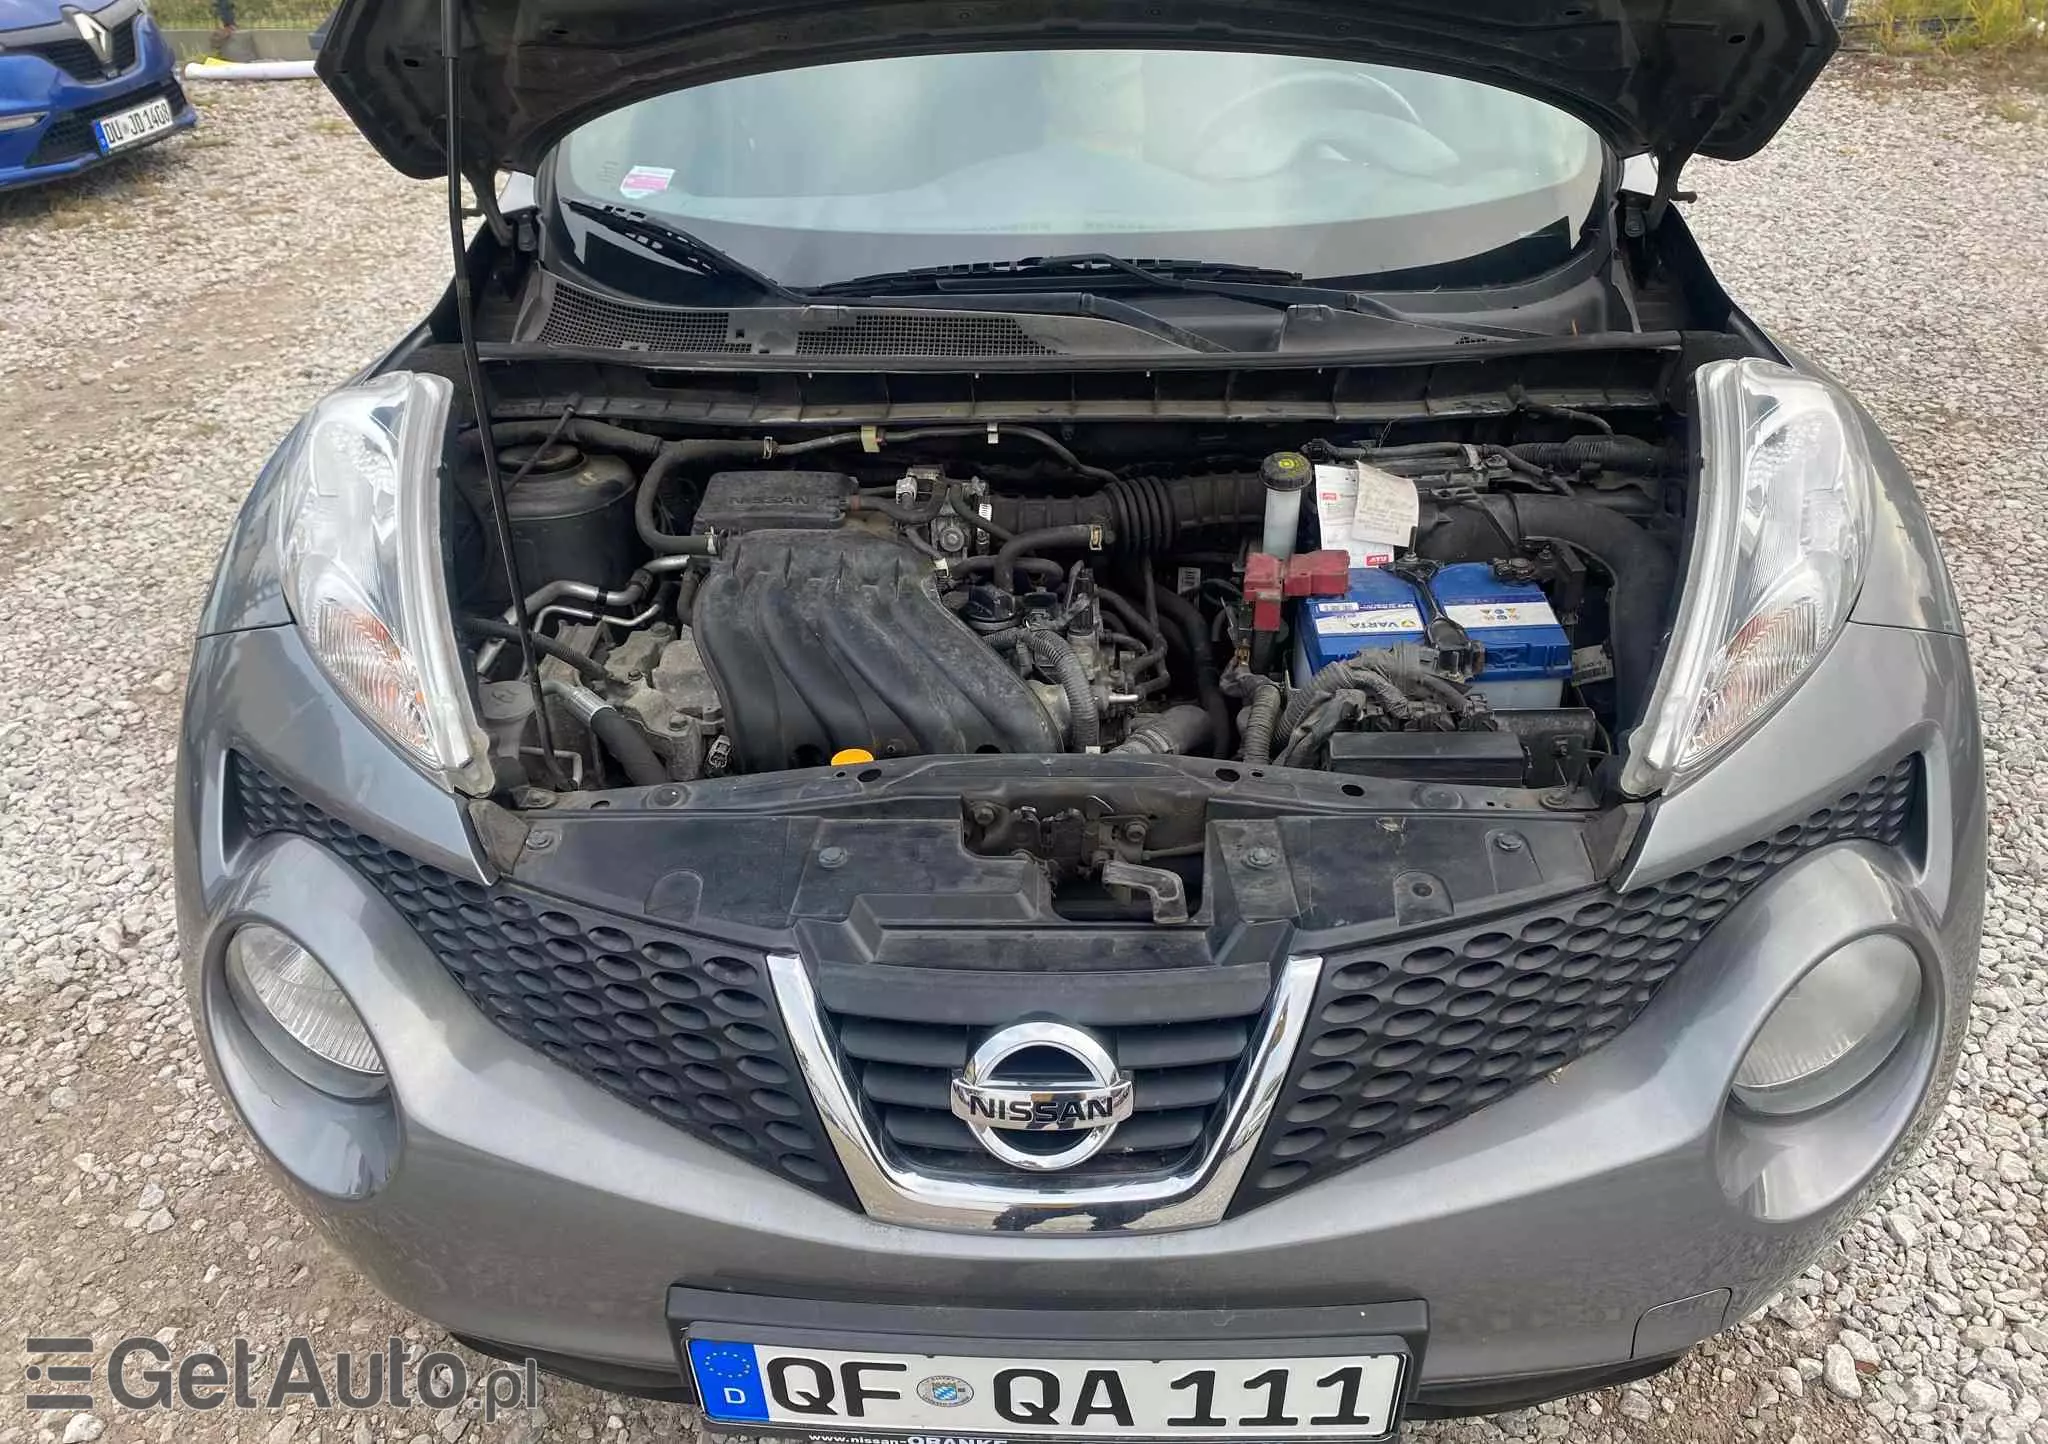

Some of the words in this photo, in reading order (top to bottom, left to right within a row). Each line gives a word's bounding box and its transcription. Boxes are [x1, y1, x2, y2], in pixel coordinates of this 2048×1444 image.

[103, 121, 124, 144] DU
[728, 494, 808, 505] NISSAN
[1350, 620, 1400, 629] VARTA
[969, 1094, 1113, 1123] NISSAN
[723, 1387, 746, 1404] D
[766, 1356, 908, 1417] QF
[993, 1368, 1135, 1427] QA
[1166, 1366, 1372, 1427] 111
